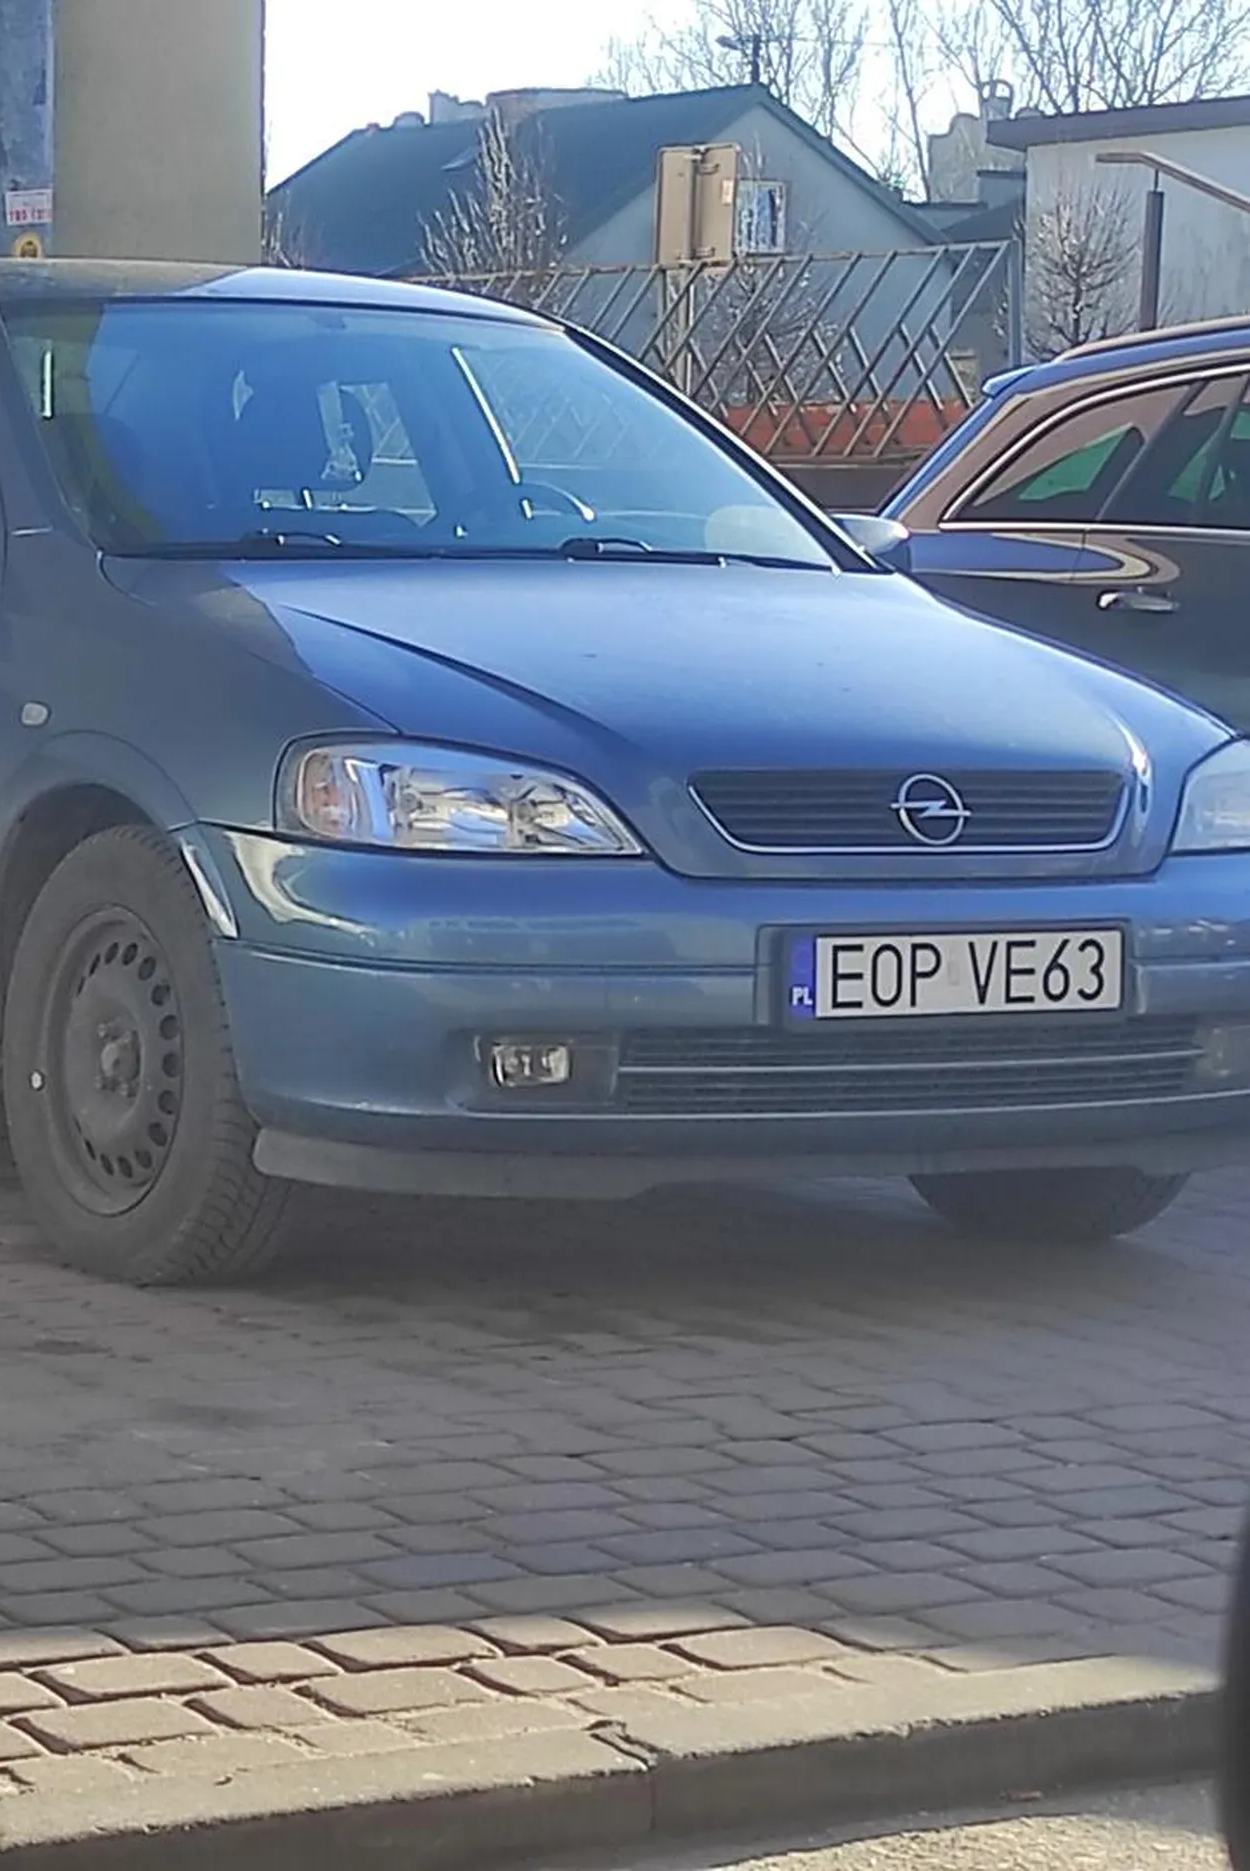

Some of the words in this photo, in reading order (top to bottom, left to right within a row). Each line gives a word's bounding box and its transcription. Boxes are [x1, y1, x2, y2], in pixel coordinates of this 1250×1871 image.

[831, 943, 941, 1008] EOP
[968, 938, 1105, 1005] VE63
[792, 986, 813, 1006] PL
